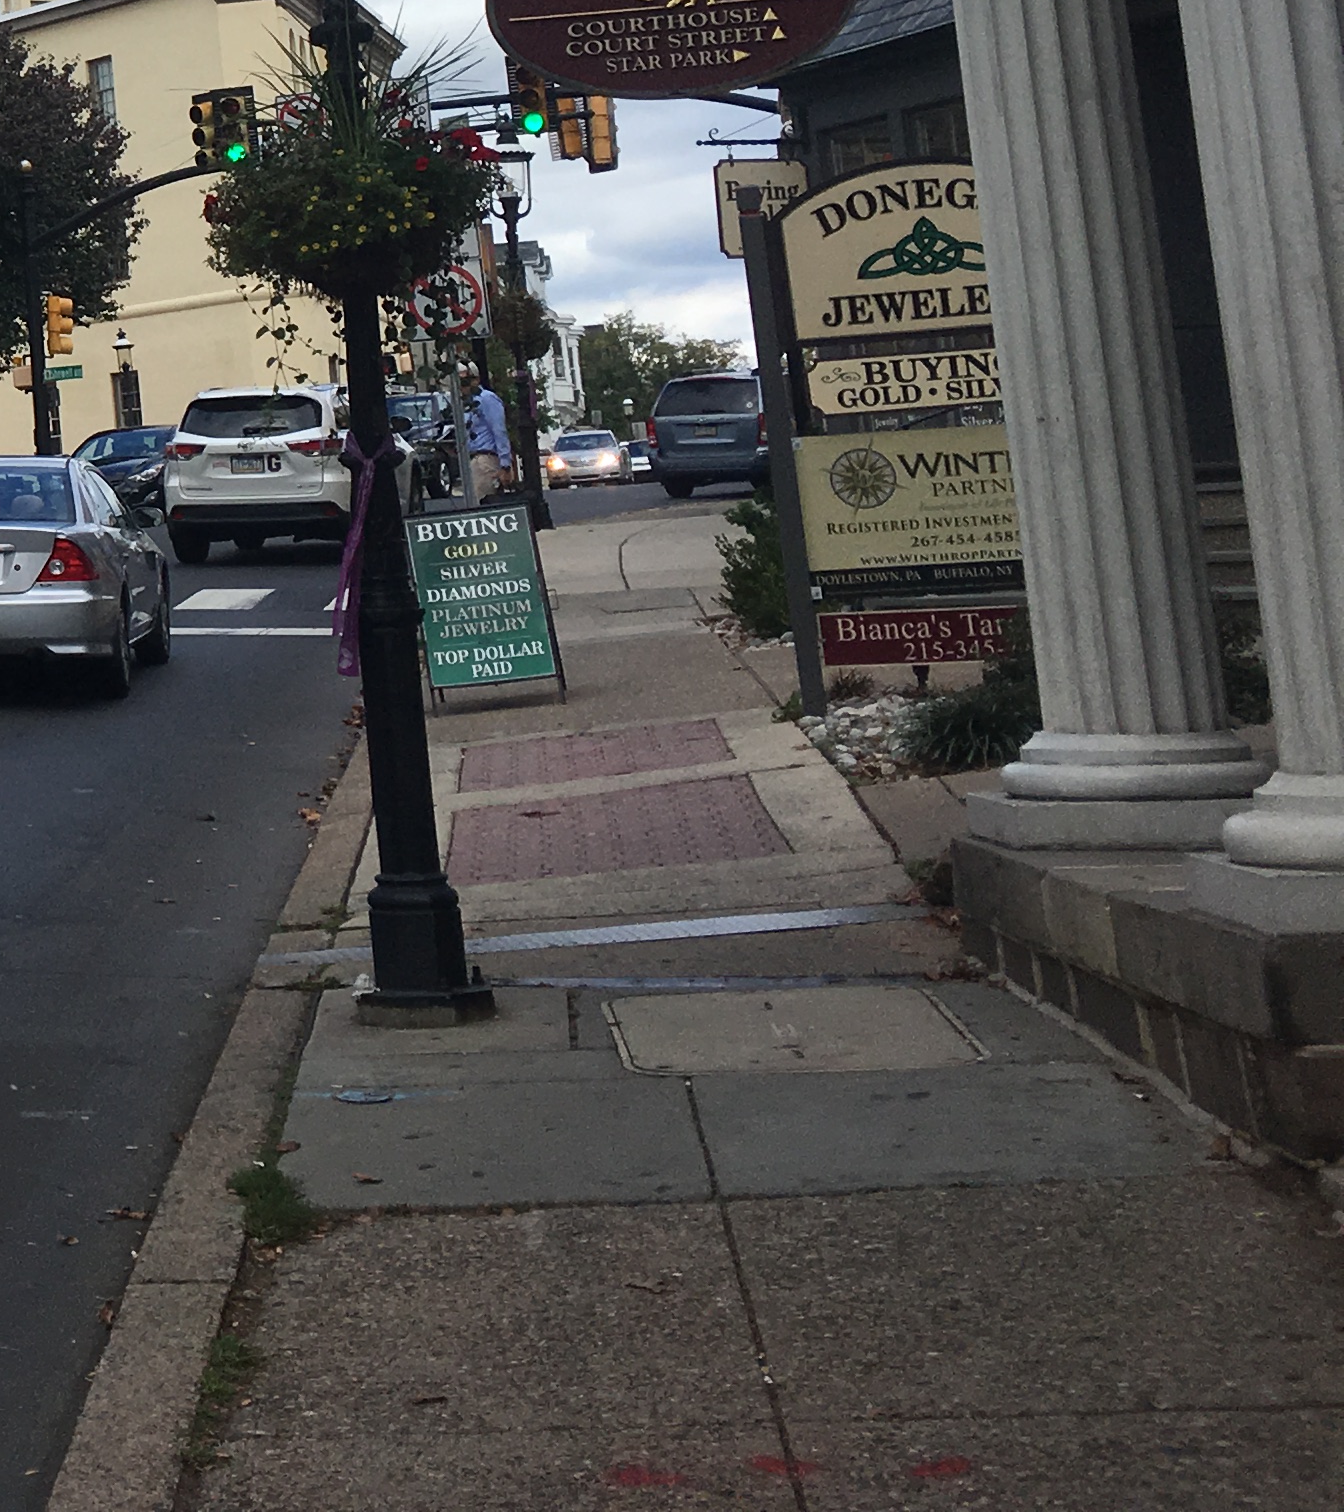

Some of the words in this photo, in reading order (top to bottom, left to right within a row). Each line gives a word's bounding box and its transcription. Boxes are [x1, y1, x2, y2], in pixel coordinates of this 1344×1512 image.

[567, 7, 758, 37] COURTHOUSE
[565, 34, 663, 56] COURT
[667, 26, 768, 49] STREET
[606, 54, 663, 73] STAR
[669, 50, 731, 69] PARK
[725, 180, 800, 201] Bing
[810, 178, 979, 239] DONEG
[821, 283, 992, 327] JEWELE
[860, 352, 1000, 386] BUYIN
[836, 384, 921, 409] GOLD
[414, 513, 519, 543] BUYING
[827, 518, 920, 535] REGISTERED
[925, 514, 1014, 530] INVESTMEN
[444, 541, 498, 559] GOLD
[440, 560, 509, 580] SILVER
[905, 570, 922, 581] PA
[426, 578, 531, 603] DIAMONDS
[431, 598, 532, 623] PLATINUM
[439, 616, 529, 639] JEWELRY
[836, 614, 952, 642] Bianca's
[959, 612, 1004, 638] Tar
[433, 648, 469, 665] TOP
[474, 640, 546, 662] DOLLAR
[471, 660, 513, 678] PAID
